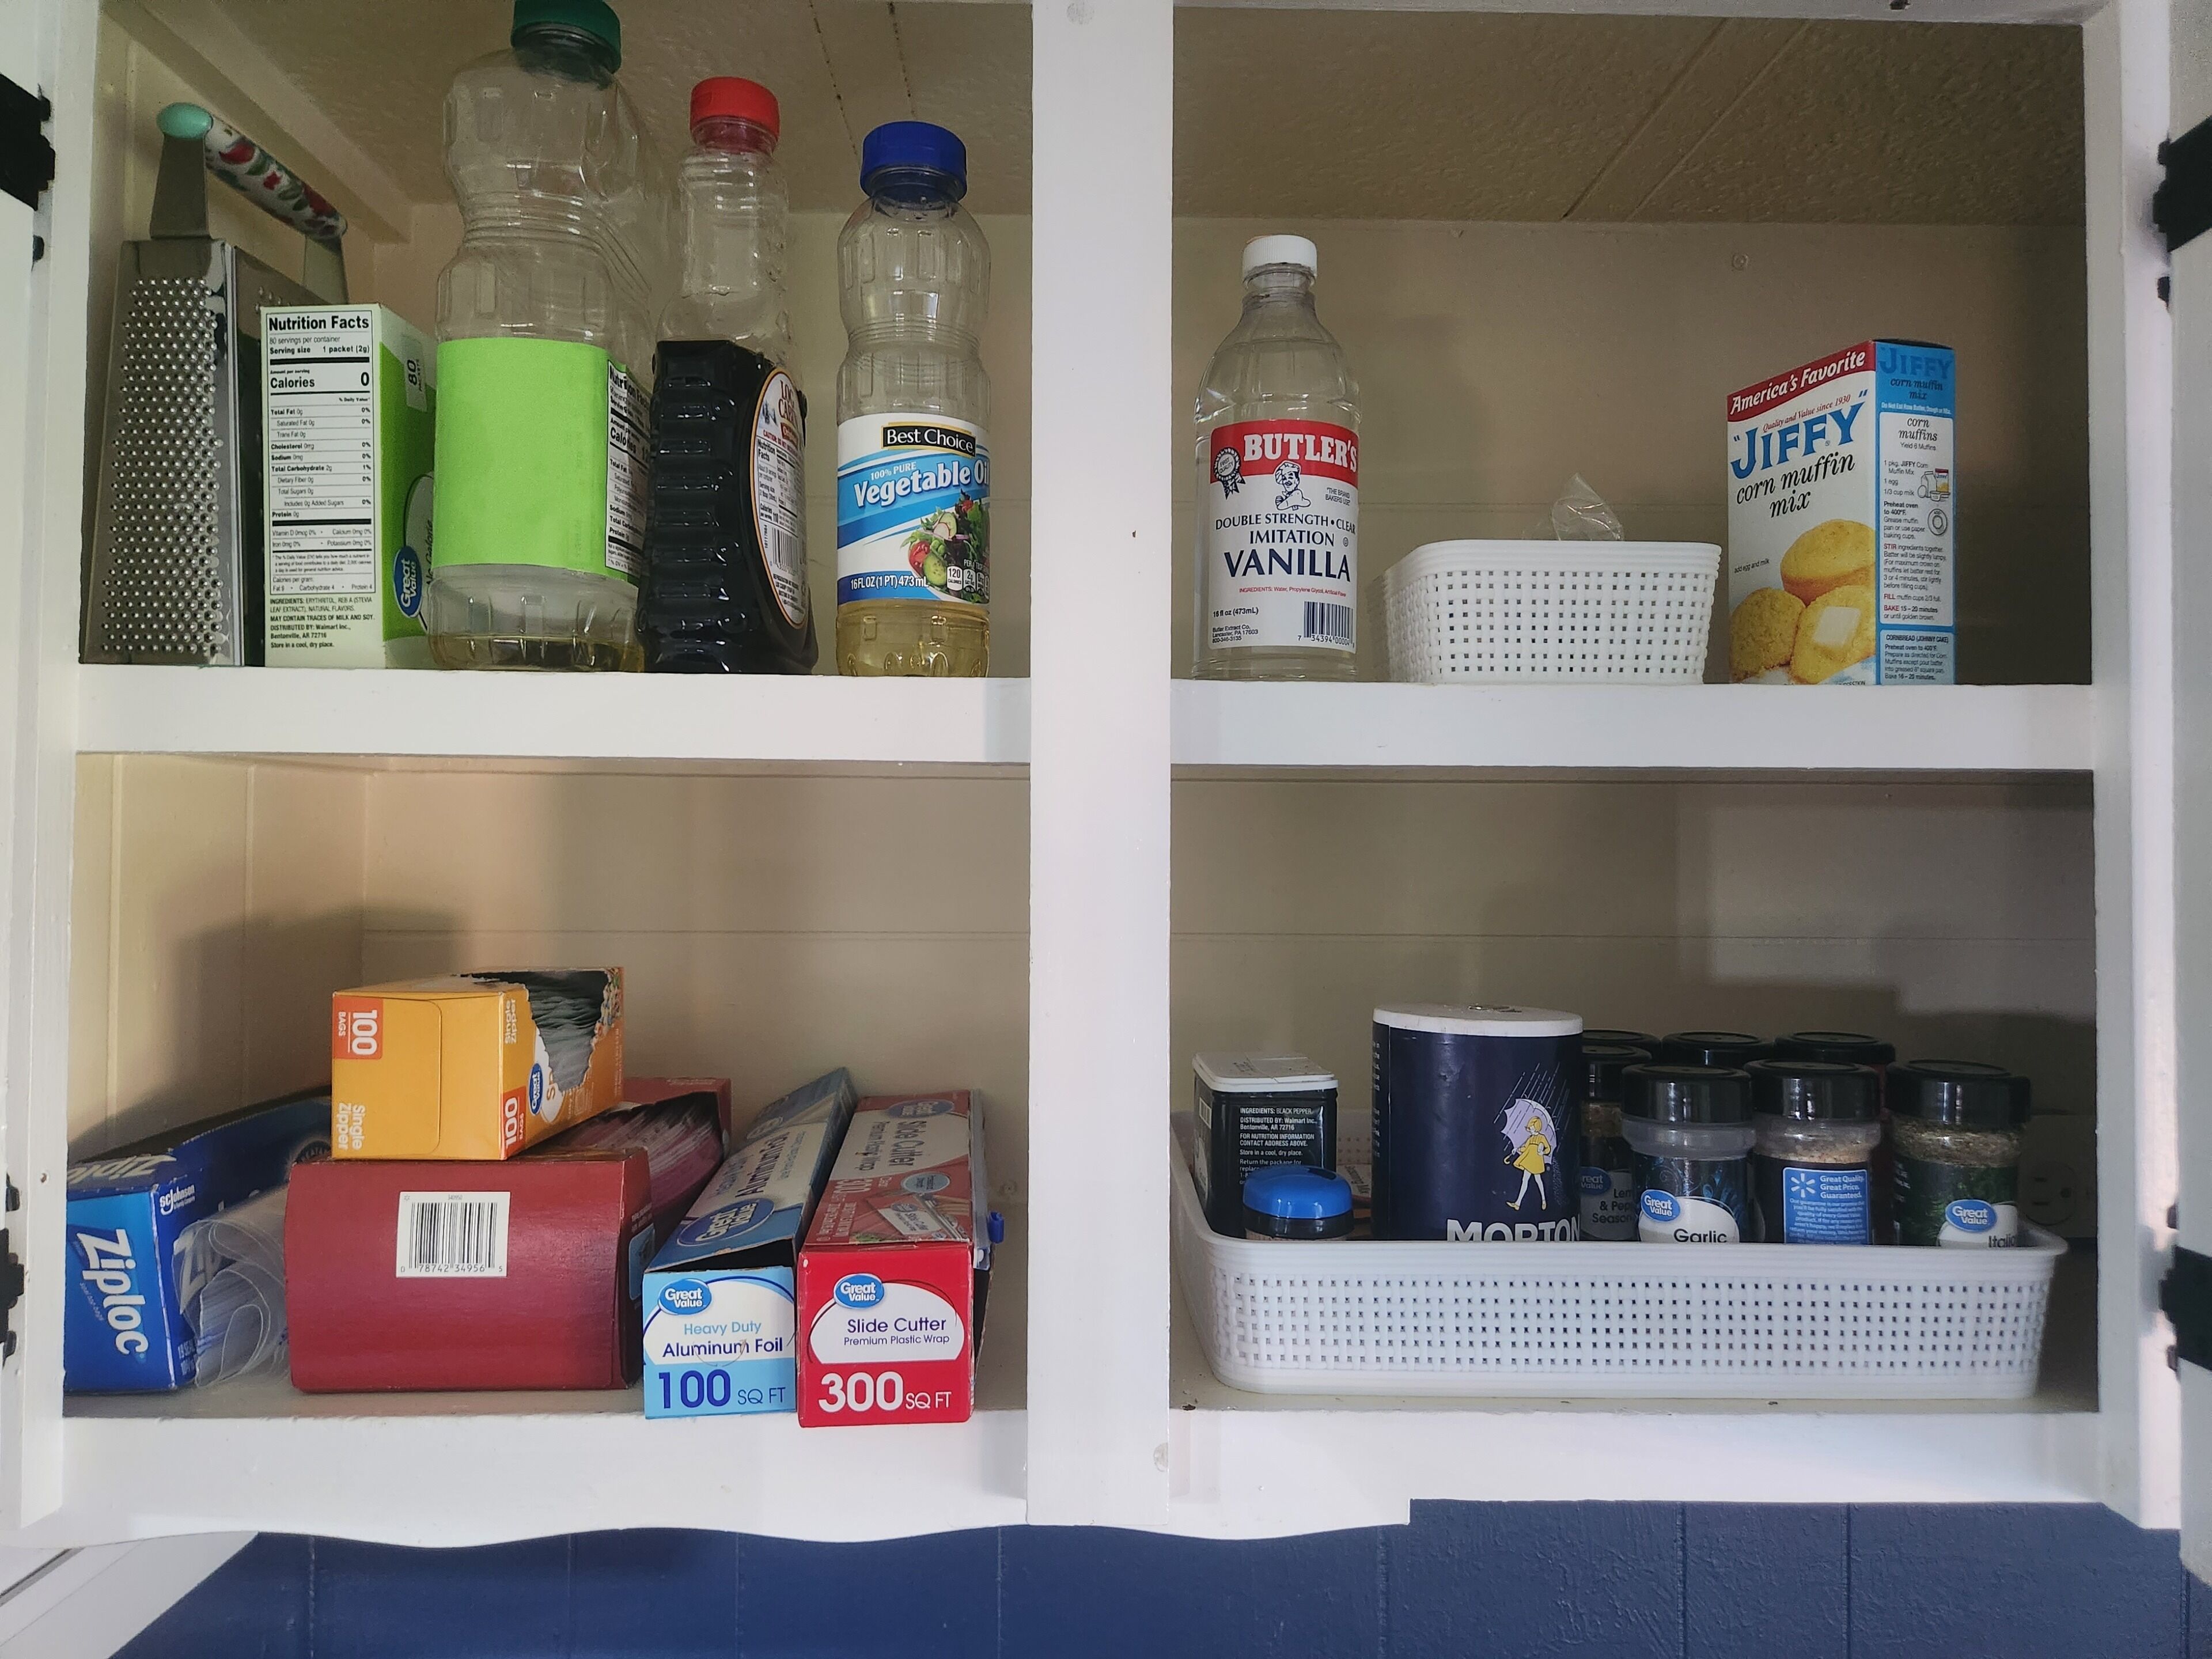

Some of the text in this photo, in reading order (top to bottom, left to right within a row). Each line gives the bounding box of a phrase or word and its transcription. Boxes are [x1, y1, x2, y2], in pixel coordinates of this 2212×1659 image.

[269, 316, 369, 331] Nutrition Facts
[356, 345, 369, 353] (2g)
[271, 372, 369, 388] Calories 0
[407, 360, 417, 385] 80
[1730, 351, 1866, 415] America's Favorite
[1891, 378, 1943, 391] corn muffin
[1908, 390, 1927, 400] mix
[1763, 395, 1851, 433] Quality and Value since 1930
[1907, 418, 1929, 428] corn
[887, 429, 973, 453] Best Choice
[1899, 430, 1938, 441] muffins
[1243, 434, 1358, 473] BUTLER'S
[870, 462, 916, 480] 100% PURE
[1737, 452, 1855, 505] corn muffin
[854, 460, 989, 507] Vegetable Oil
[1770, 490, 1810, 518] mix
[1216, 513, 1355, 534] DOUBLE STRENGTH CLEAR
[1250, 529, 1334, 547] IMITATION
[949, 569, 960, 578] 120
[1224, 548, 1351, 582] VANILLA
[401, 559, 411, 607] Great
[899, 575, 929, 588] 473mL
[1233, 607, 1259, 616] (473mL)
[1311, 635, 1332, 643] 34394
[338, 1012, 346, 1037] BAGS
[509, 998, 517, 1044] Zipper
[351, 1009, 378, 1056] 100
[338, 1102, 351, 1150] Zipper
[351, 1105, 366, 1151] Single
[505, 1096, 518, 1149] 100
[894, 1120, 927, 1138] Slide
[888, 1140, 924, 1166] Cutter
[1600, 1200, 1607, 1211] &
[1644, 1195, 1673, 1210] Great
[1649, 1205, 1672, 1216] Value
[1952, 1206, 1987, 1218] Great
[695, 1207, 739, 1241] Great
[1673, 1228, 1727, 1243] Garlic
[76, 1229, 149, 1355] Ziploc
[665, 1288, 703, 1301] Great
[840, 1282, 876, 1294] Great
[848, 1293, 876, 1301] Value
[674, 1298, 703, 1308] Value
[684, 1320, 762, 1335] Heavy Duty
[847, 1317, 946, 1334] Slide Cutter
[662, 1337, 783, 1357] Aluminum Foil
[844, 1334, 950, 1346] Premium Plastic Wrap
[659, 1369, 786, 1409] 100 SQ FT
[818, 1371, 952, 1412] 300 SQ FT
